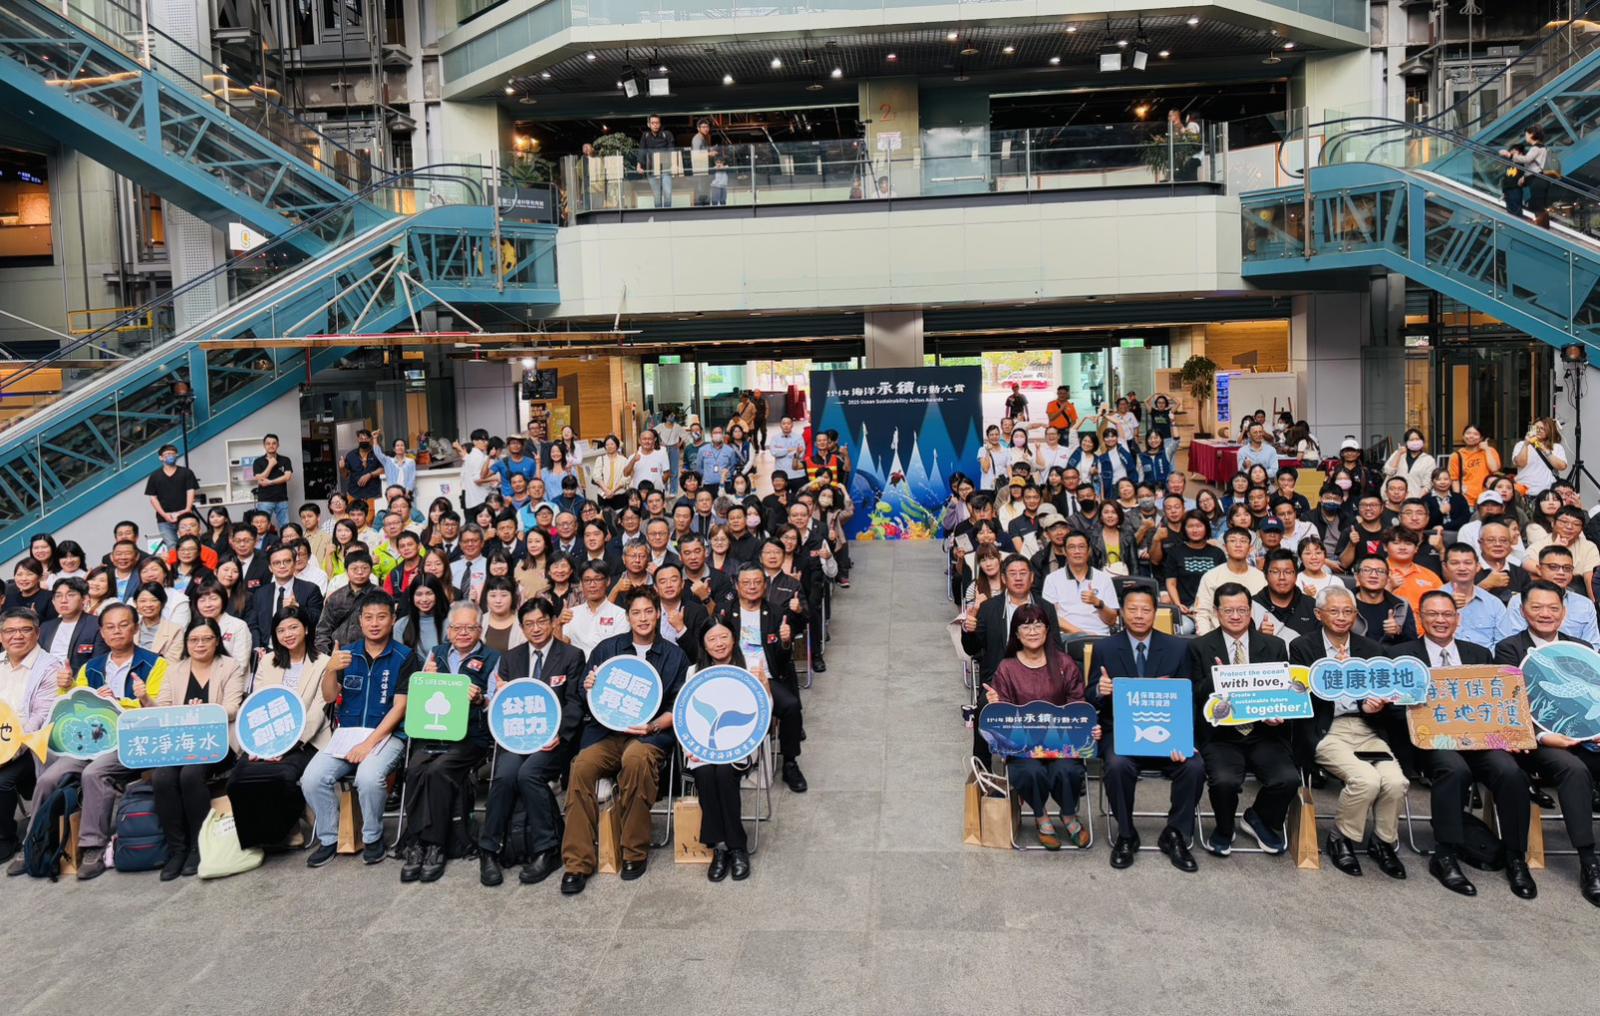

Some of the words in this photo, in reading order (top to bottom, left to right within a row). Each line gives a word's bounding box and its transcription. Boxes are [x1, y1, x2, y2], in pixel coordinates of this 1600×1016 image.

[414, 676, 423, 686] 15
[448, 679, 463, 687] LAND
[1221, 679, 1248, 689] with
[1253, 678, 1284, 688] love,
[1322, 668, 1415, 690] 健康棲地
[502, 695, 546, 715] 公私
[1126, 691, 1139, 706] 14
[1434, 699, 1521, 726] 在地守護
[503, 717, 548, 737] 協力
[127, 732, 220, 757] 潔淨海水
